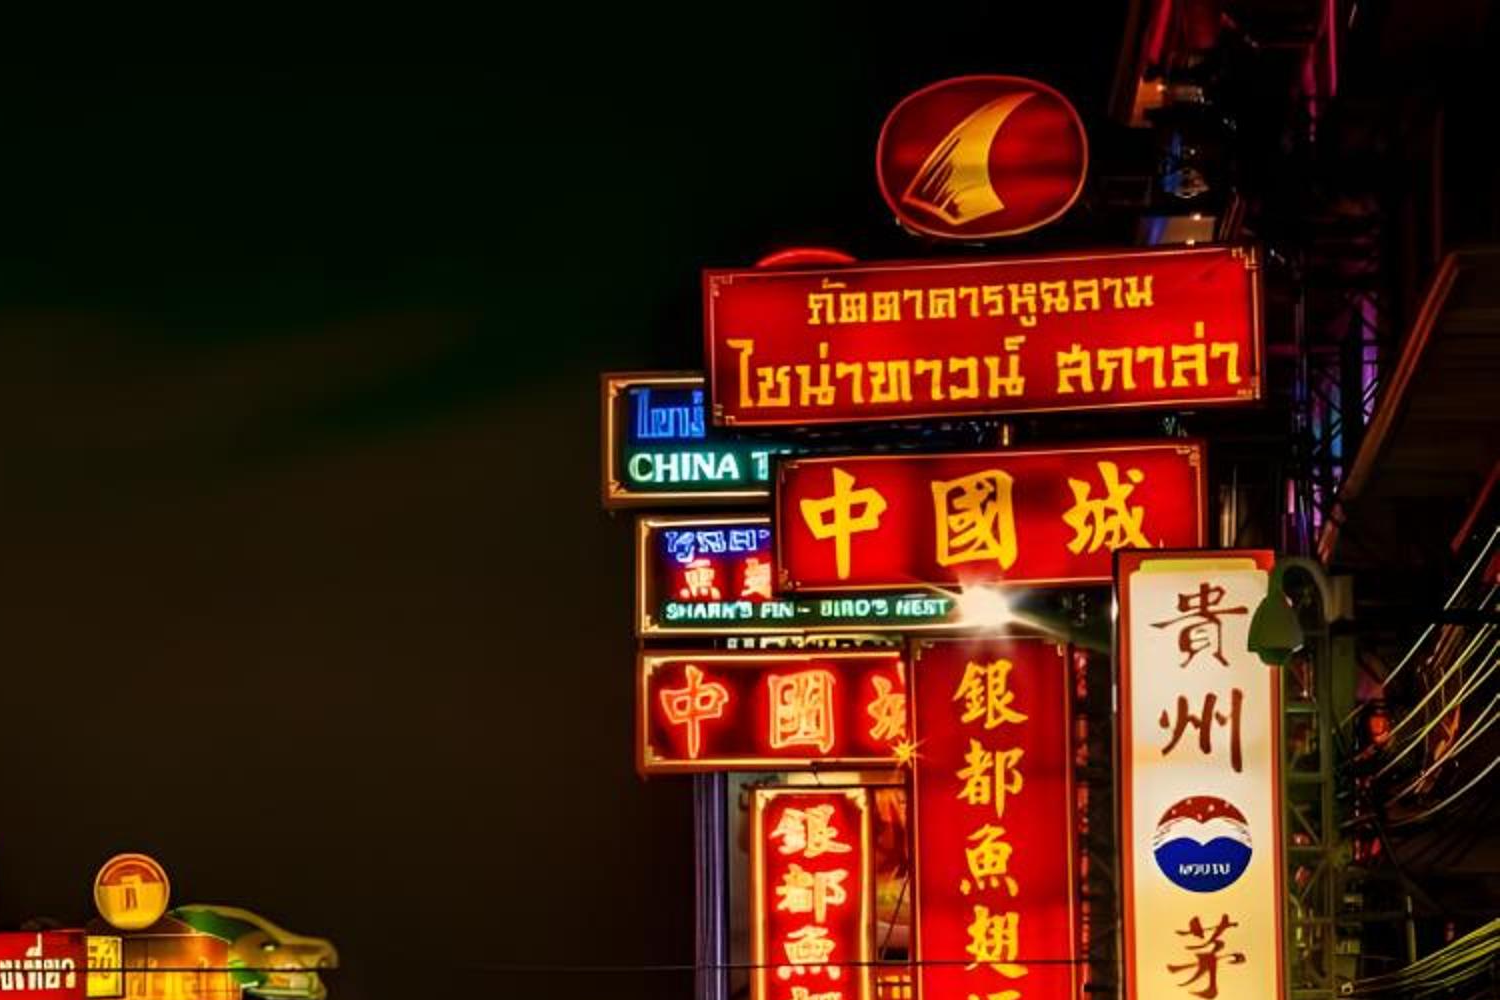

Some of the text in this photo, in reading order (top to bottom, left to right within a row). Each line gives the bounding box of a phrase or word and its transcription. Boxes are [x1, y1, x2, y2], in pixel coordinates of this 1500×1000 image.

[629, 452, 740, 482] CHINA
[799, 459, 1160, 580] 中國城
[760, 601, 795, 619] FIN
[1149, 582, 1249, 774] 貴州
